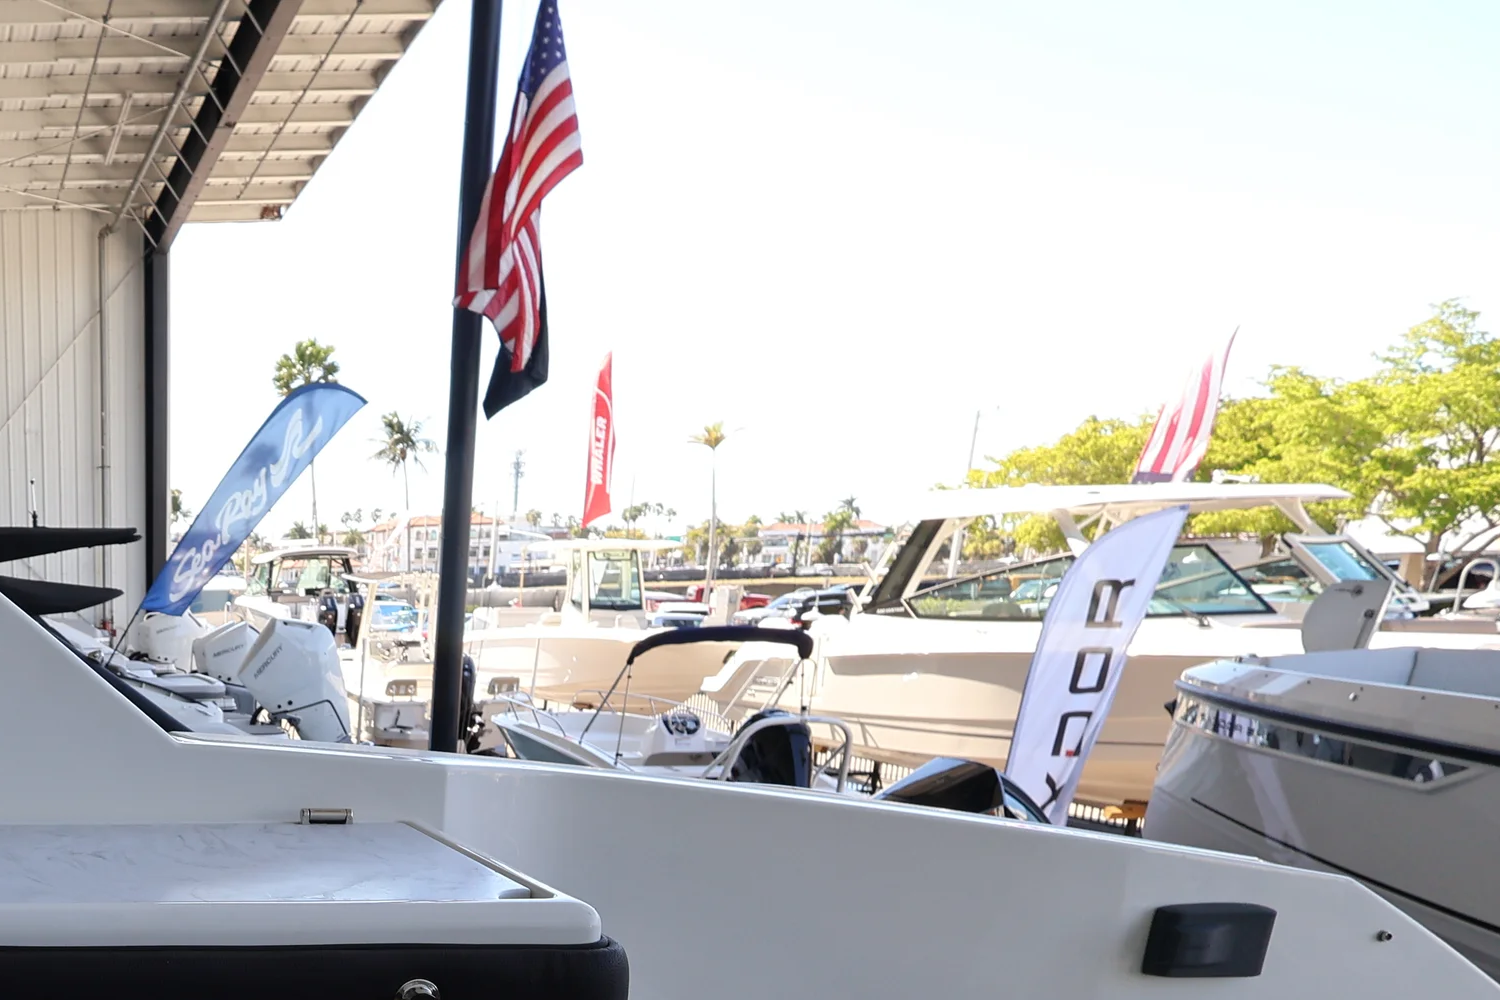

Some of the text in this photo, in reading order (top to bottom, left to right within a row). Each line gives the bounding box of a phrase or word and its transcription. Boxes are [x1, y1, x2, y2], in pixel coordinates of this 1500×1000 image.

[590, 415, 608, 485] WHALER
[169, 467, 267, 603] Sea Ray
[212, 644, 244, 658] MERCURY
[254, 644, 283, 680] MERCURY
